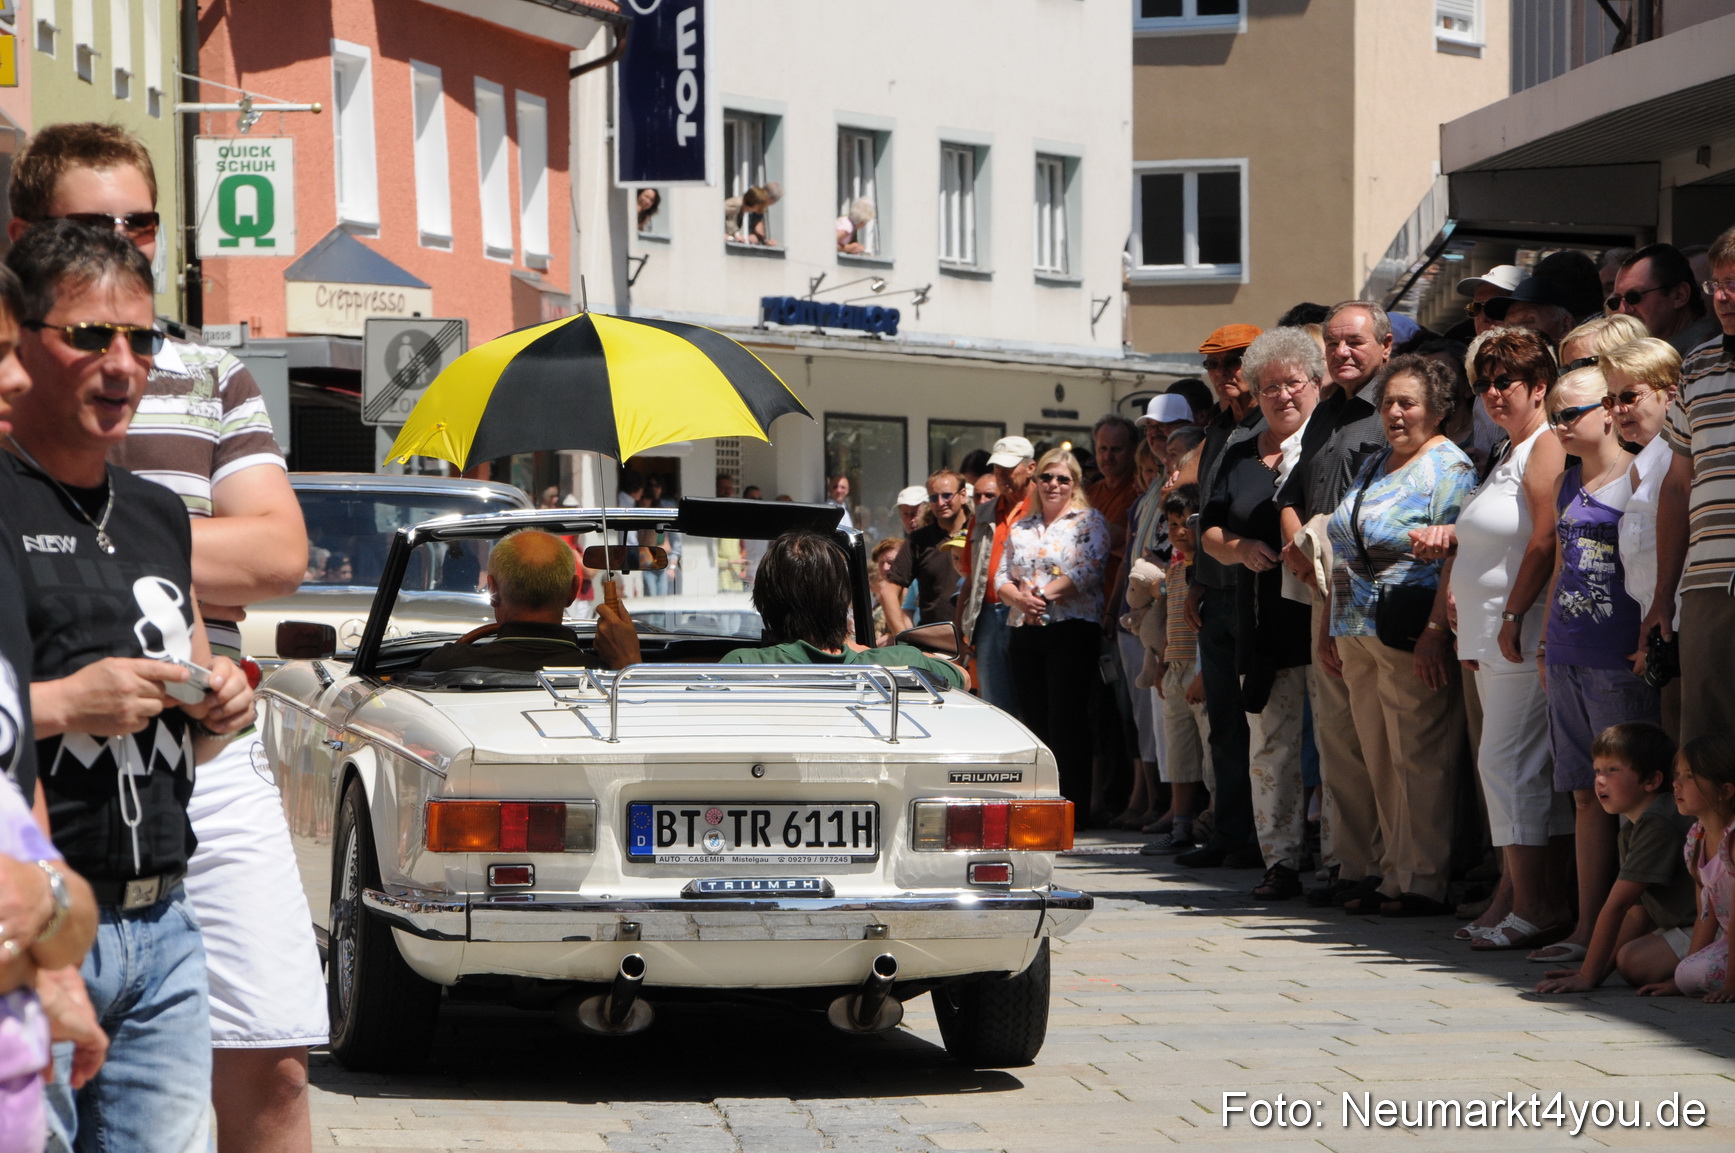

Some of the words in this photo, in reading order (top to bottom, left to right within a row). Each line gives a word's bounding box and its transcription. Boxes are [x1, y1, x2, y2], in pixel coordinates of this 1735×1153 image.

[676, 6, 699, 147] TOM
[218, 145, 272, 158] QUICK
[216, 160, 276, 172] SCHUH
[315, 284, 405, 320] Creppresso
[203, 330, 232, 344] gasse
[22, 535, 77, 553] NEW
[952, 773, 1019, 782] TRIUMPH
[656, 810, 701, 848] BT
[727, 810, 772, 848] TR
[782, 810, 872, 848] 611H
[637, 836, 646, 847] D
[732, 856, 769, 865] Mistelgau
[707, 880, 814, 889] TRIUMPH
